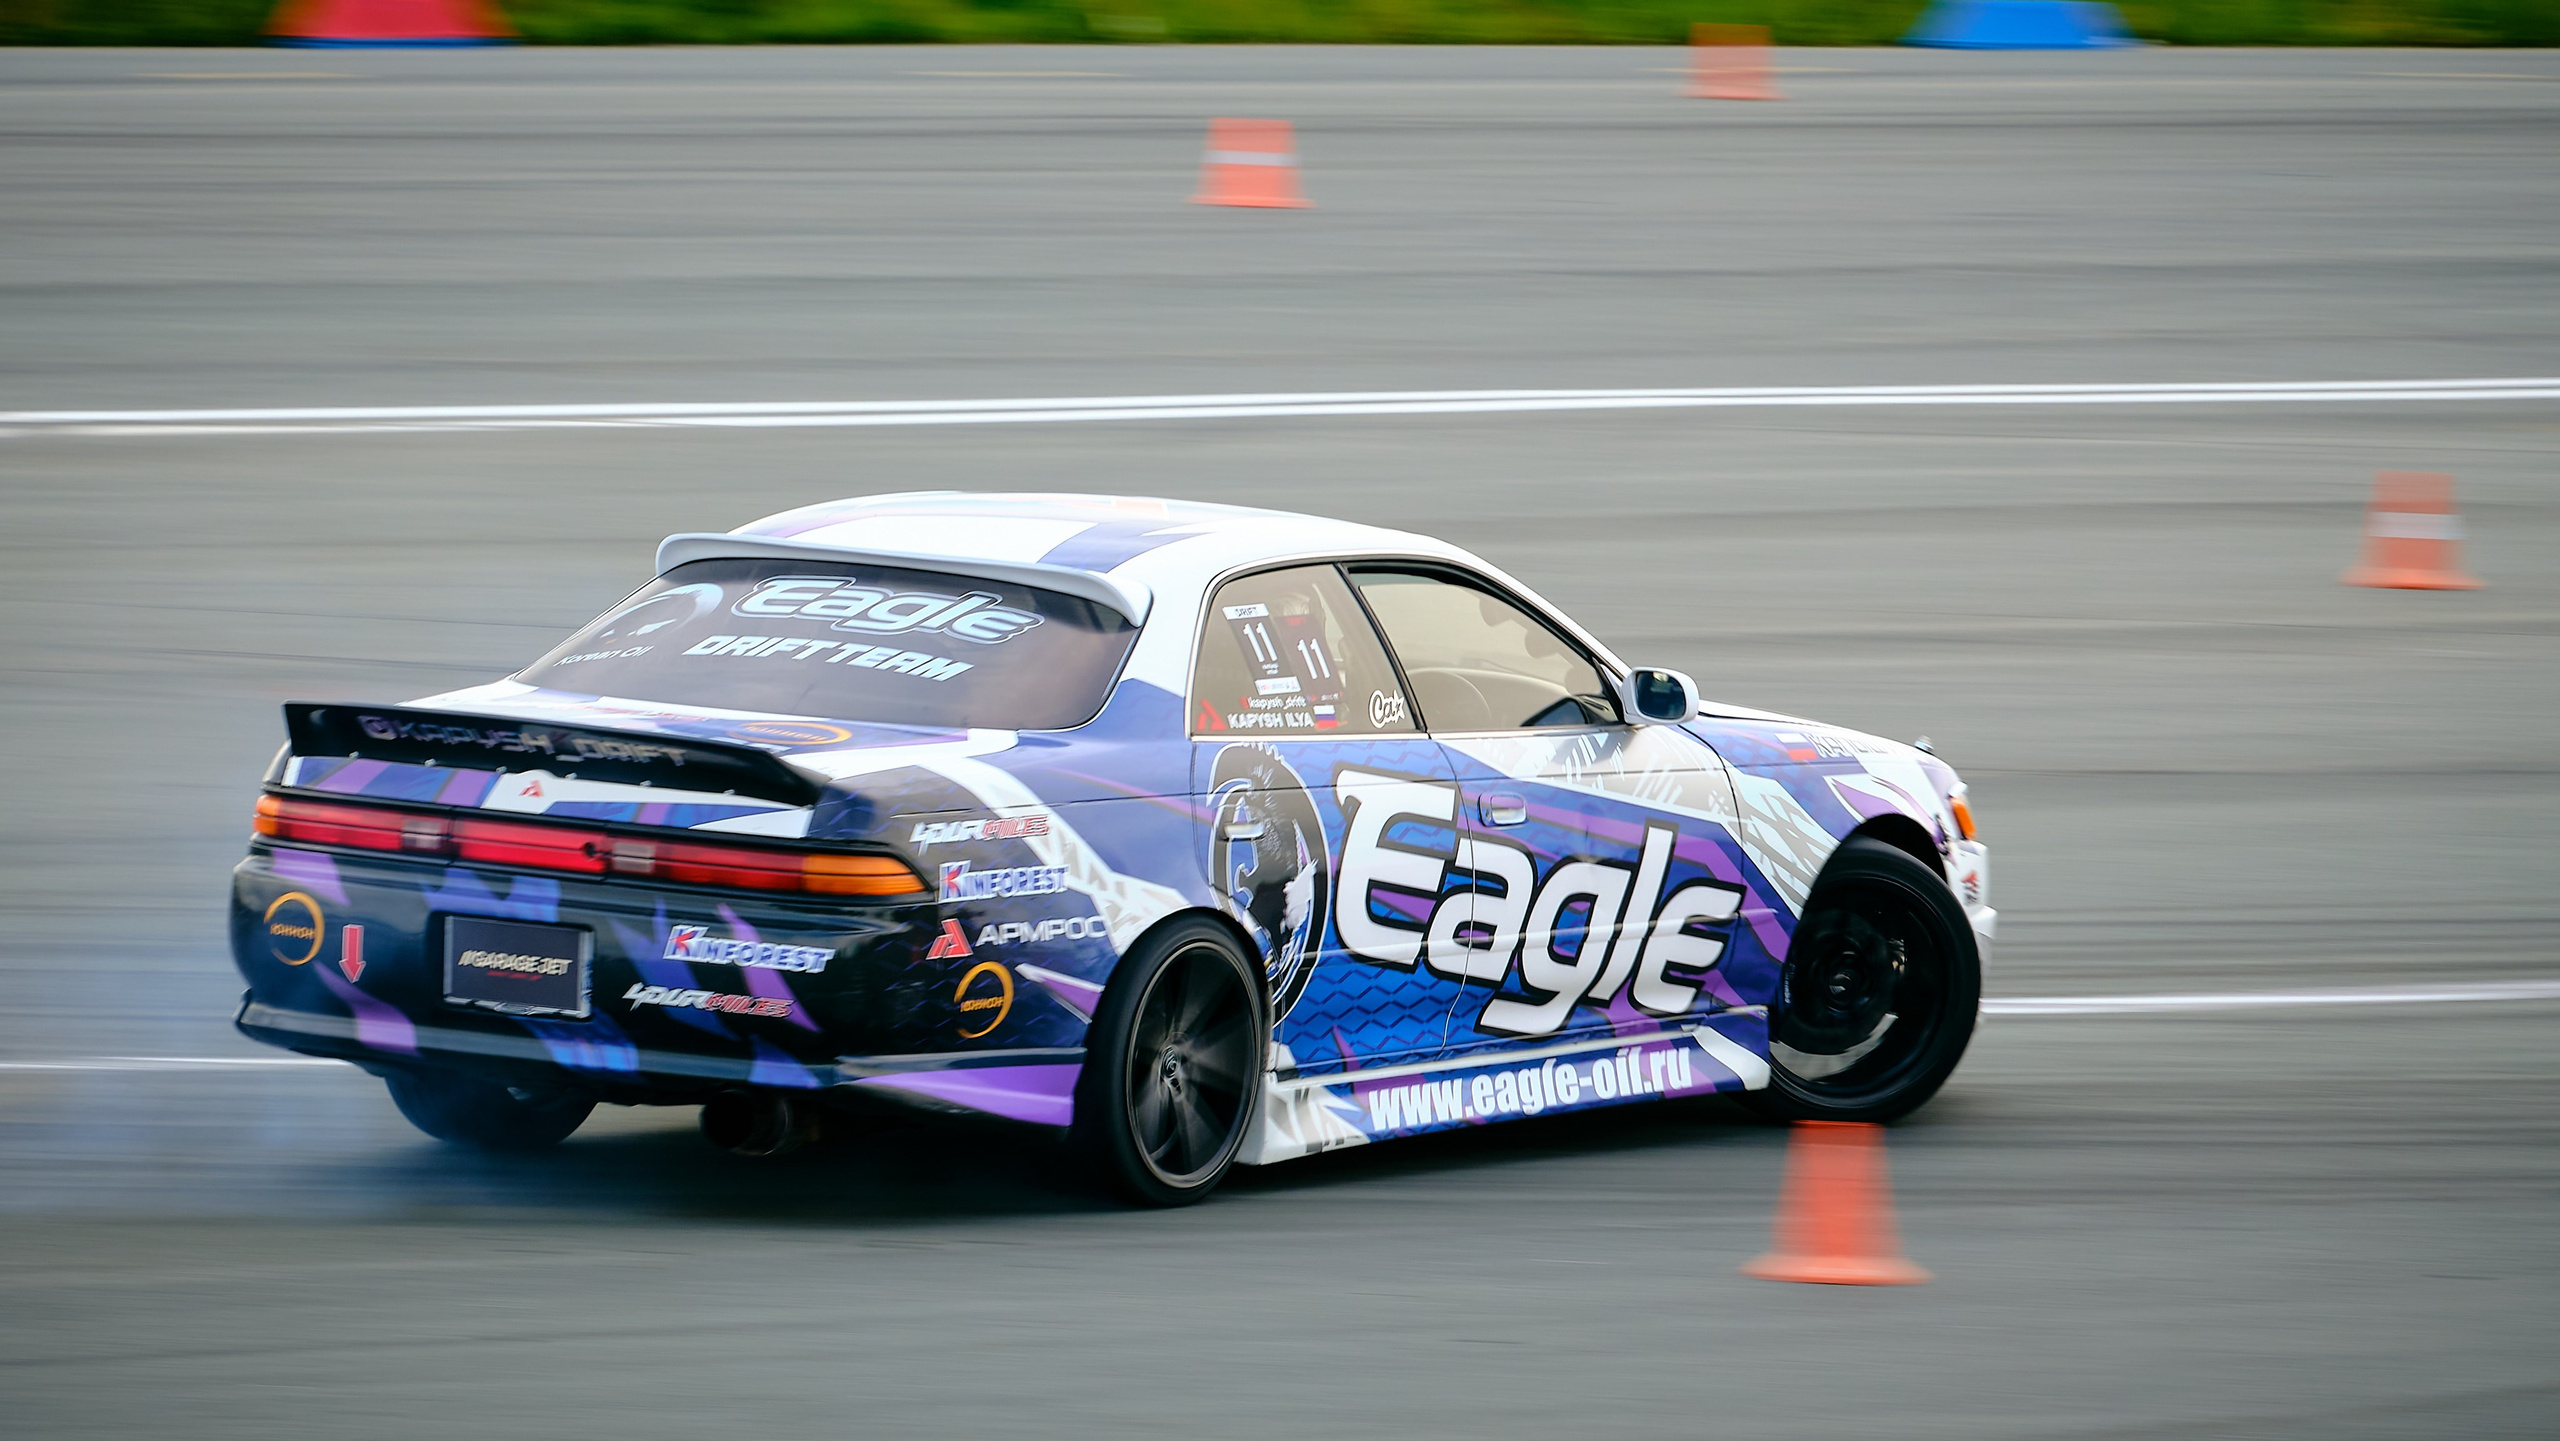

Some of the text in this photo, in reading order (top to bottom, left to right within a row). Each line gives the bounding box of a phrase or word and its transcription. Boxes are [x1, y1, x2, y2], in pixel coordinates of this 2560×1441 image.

[734, 576, 1043, 643] Eagle
[682, 635, 975, 682] DRIFT TEAM
[1243, 622, 1278, 662] 11
[1297, 638, 1330, 680] 11
[1227, 711, 1315, 729] KAPYSH ILYA
[1336, 769, 1743, 1036] Eagle
[1368, 1046, 1692, 1130] www.eagle-oil.ru
